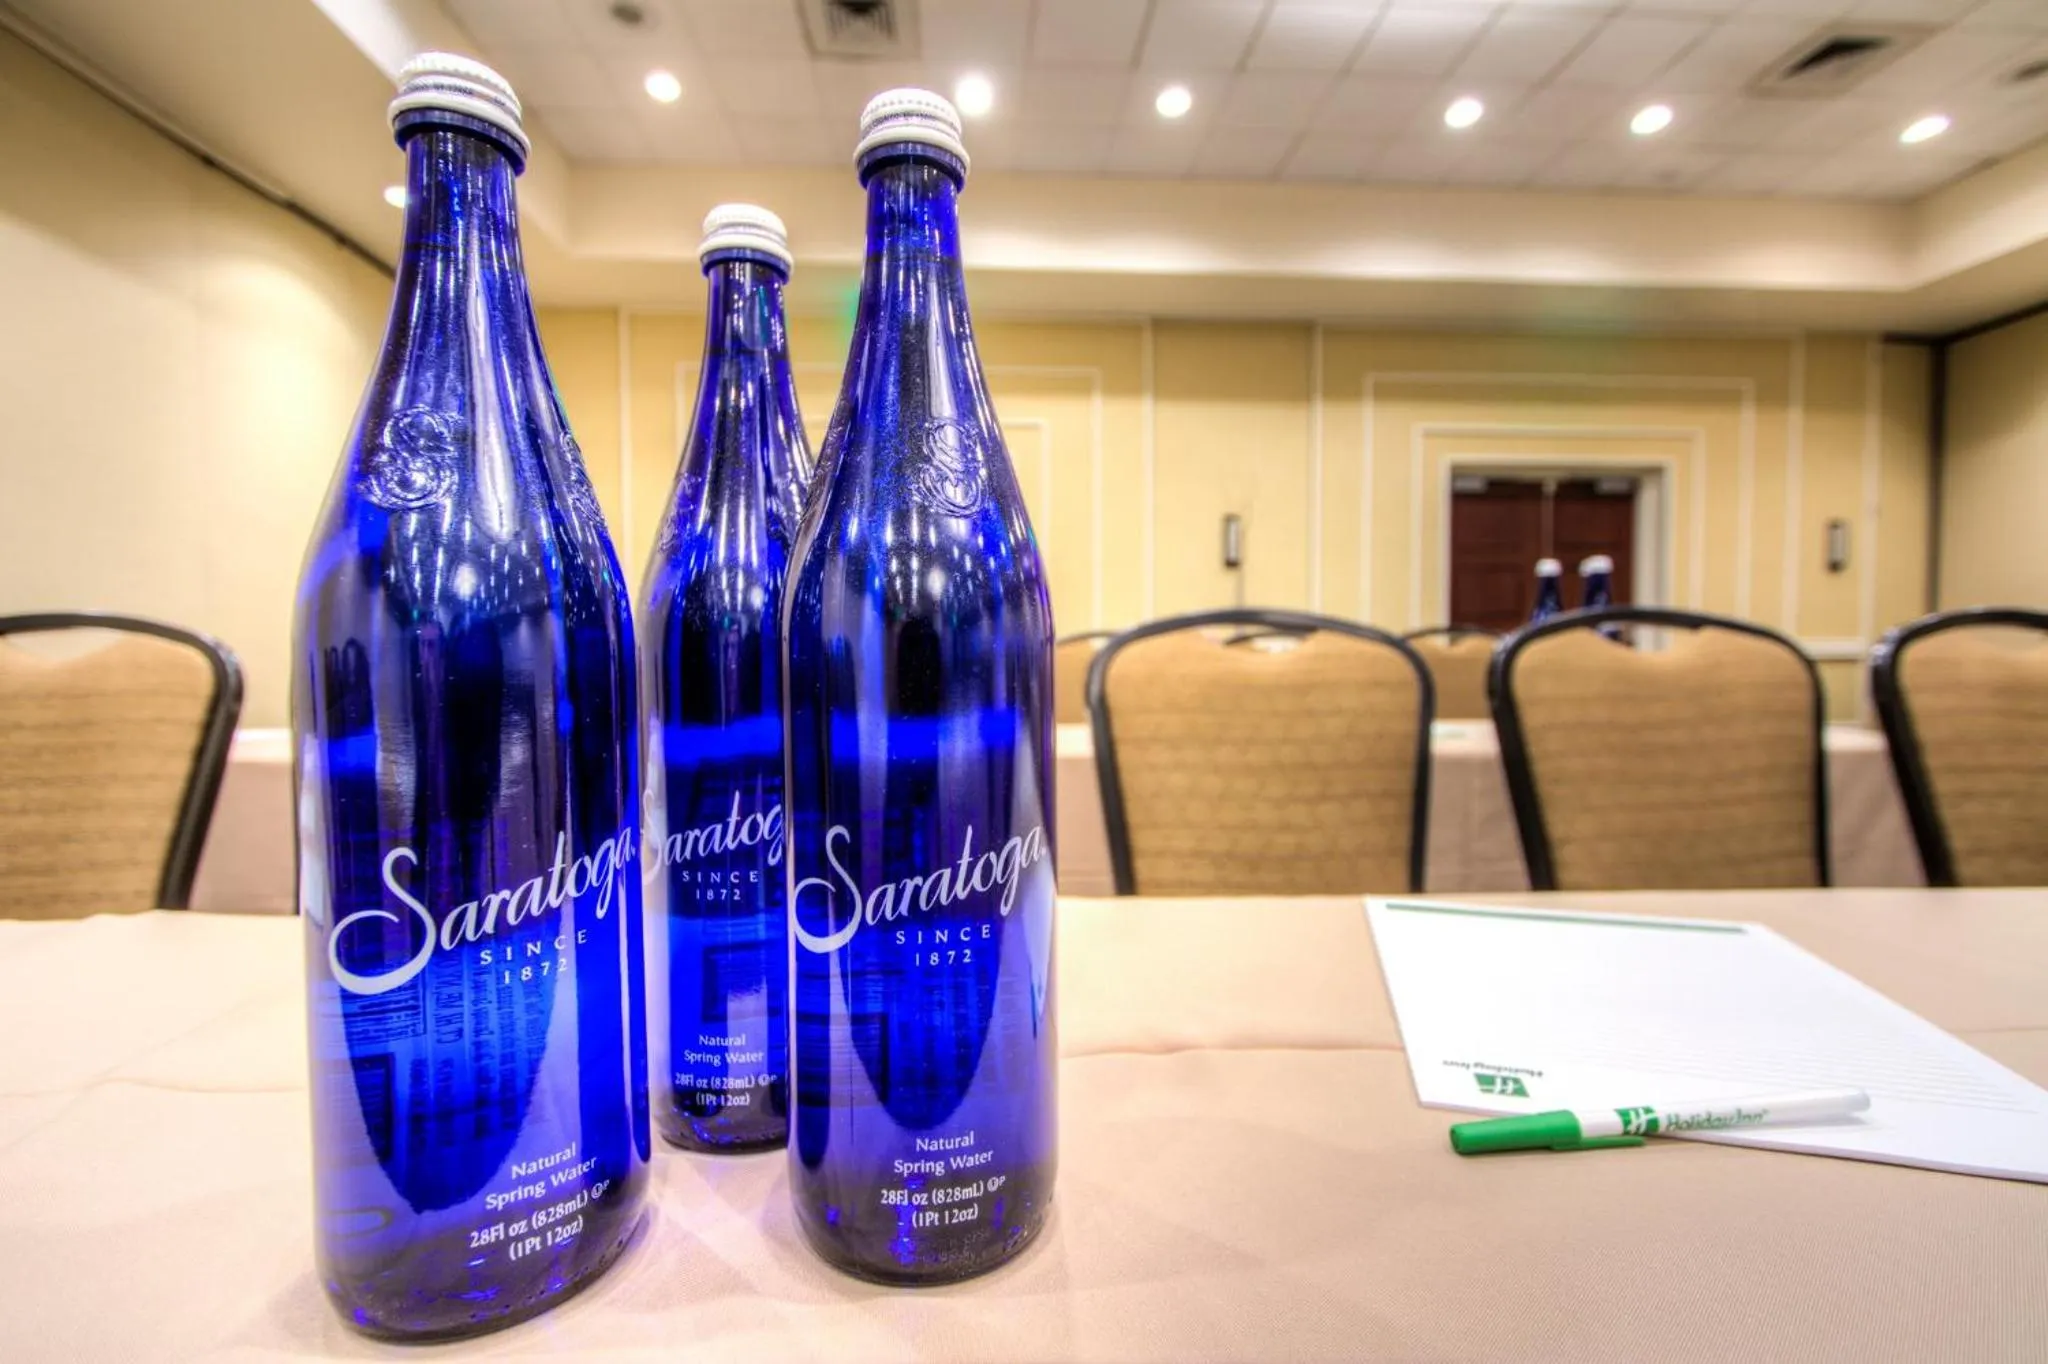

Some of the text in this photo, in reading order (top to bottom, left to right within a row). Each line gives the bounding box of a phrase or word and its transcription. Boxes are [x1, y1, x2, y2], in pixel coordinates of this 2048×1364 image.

[641, 788, 785, 886] Saratog
[682, 870, 759, 883] SINCE
[695, 888, 741, 901] 1872
[895, 923, 992, 945] SINCE
[480, 929, 588, 966] SINCE
[915, 949, 972, 967] 1872
[505, 957, 568, 984] 1872
[699, 1033, 746, 1047] Natural
[684, 1049, 764, 1067] Spring Water
[696, 1078, 708, 1089] oz
[711, 1075, 755, 1090] (828mL)
[1666, 1111, 1735, 1131] Holiday
[915, 1130, 974, 1152] Natural
[512, 1141, 576, 1180] Natural
[894, 1150, 994, 1178] Spring Water
[485, 1157, 597, 1211] Spring Water
[911, 1192, 929, 1206] oz
[931, 1179, 984, 1205] (828mL)
[469, 1221, 505, 1248] 28Fl
[508, 1219, 528, 1237] oz
[532, 1190, 588, 1230] (828mL)
[911, 1210, 940, 1228] (1Pt
[509, 1236, 542, 1261] (1Pt
